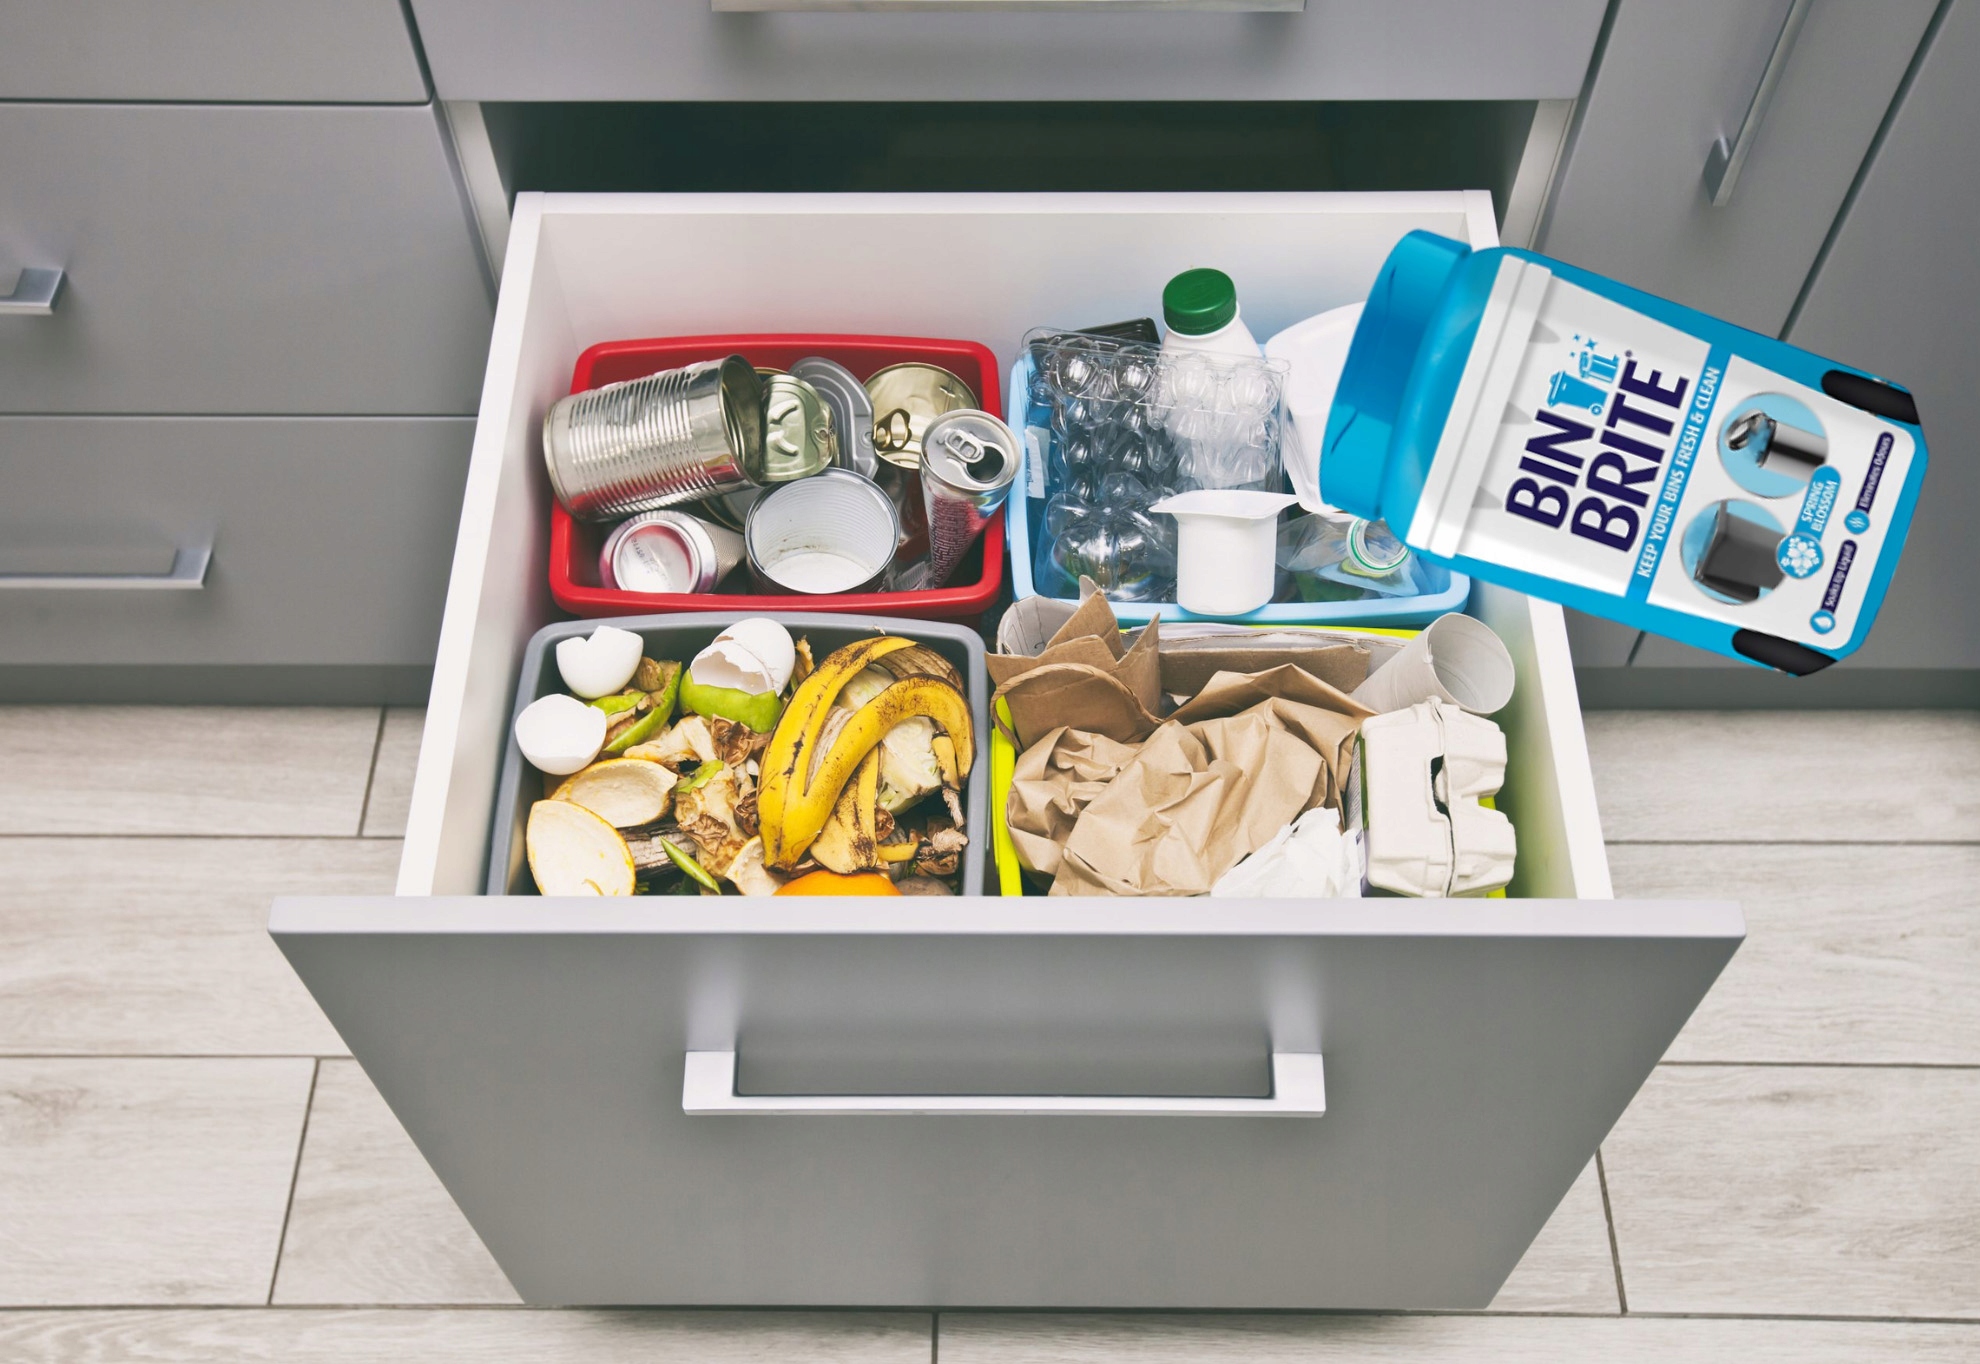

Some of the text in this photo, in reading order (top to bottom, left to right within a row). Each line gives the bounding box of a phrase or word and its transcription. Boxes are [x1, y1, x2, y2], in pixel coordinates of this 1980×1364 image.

[1505, 409, 1596, 530] BIN
[1570, 358, 1690, 553] BRITE
[1636, 366, 1721, 578] KEEP YOUR BINS FRESH & CLEAN
[1859, 436, 1892, 508] Eliminates Odours
[1801, 481, 1824, 522] SPRING
[1811, 480, 1838, 532] BLOSSOM
[1825, 577, 1840, 608] Soaks
[1837, 544, 1855, 572] Liquid
